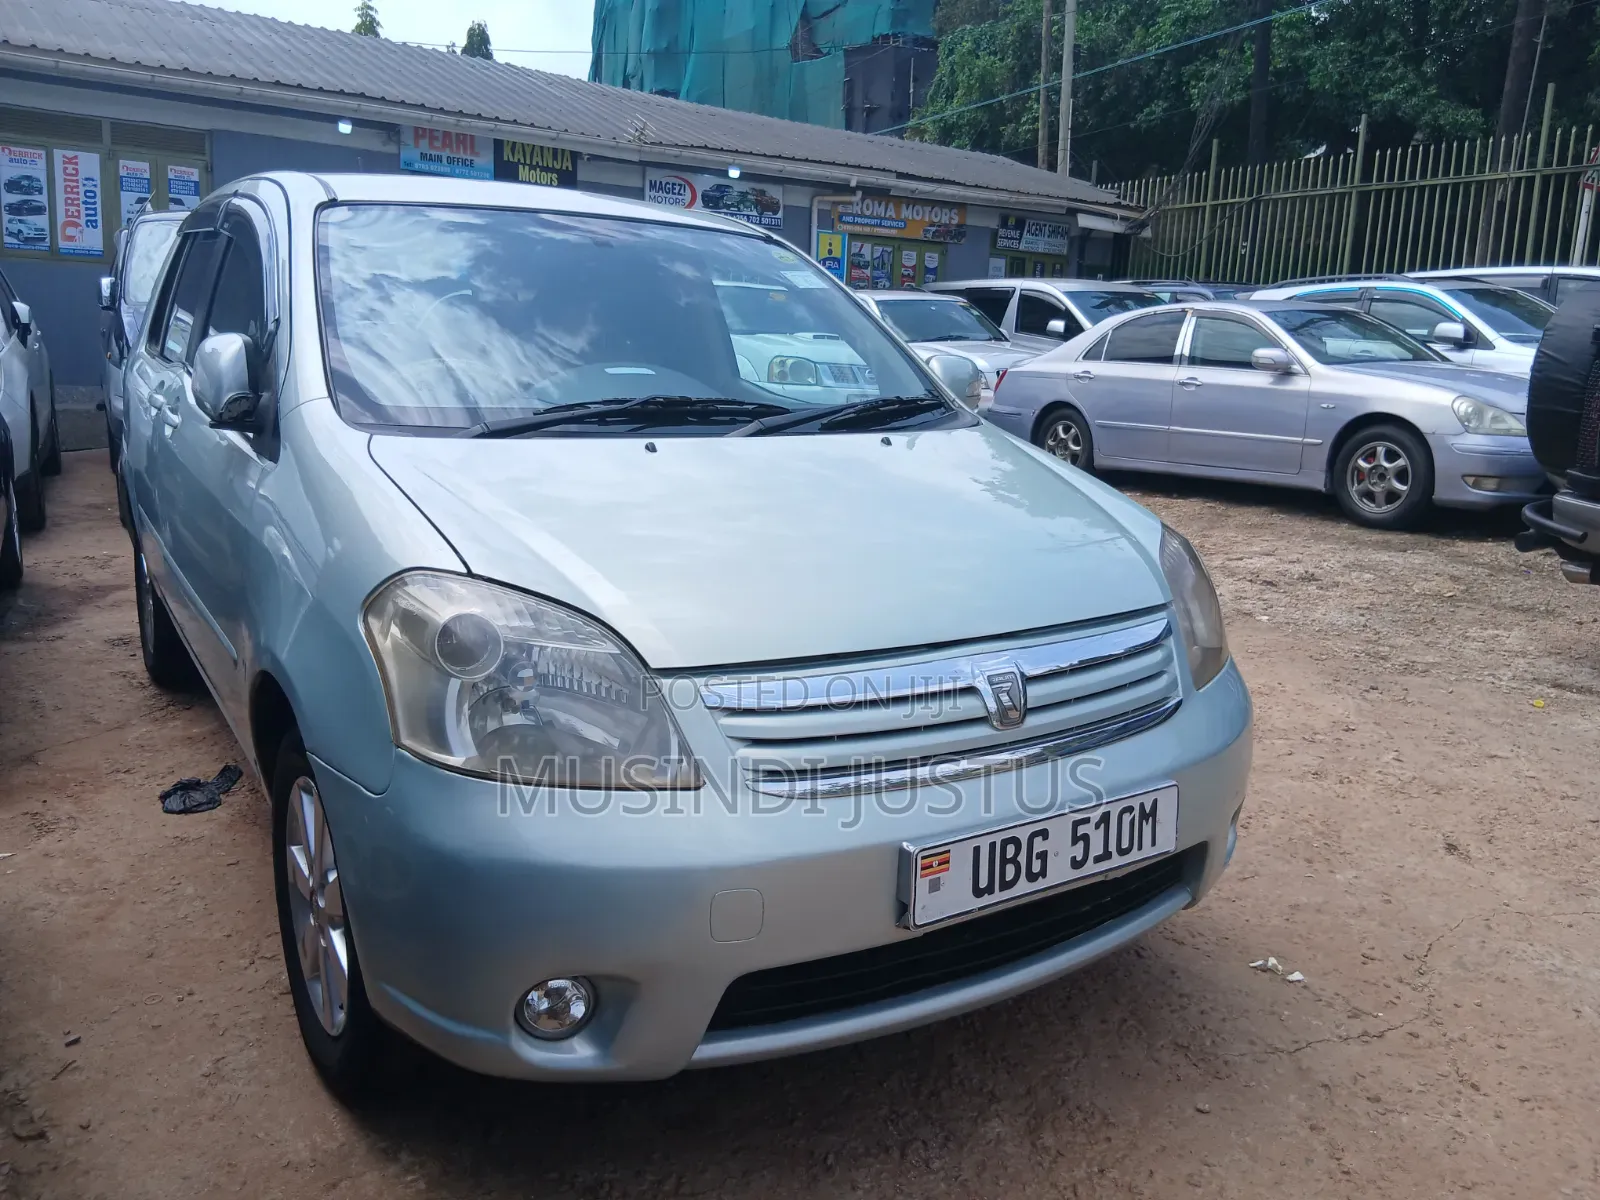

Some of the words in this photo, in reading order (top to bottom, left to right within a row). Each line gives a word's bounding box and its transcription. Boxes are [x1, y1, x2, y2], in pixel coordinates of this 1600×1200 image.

[413, 126, 480, 157] PEARL
[1, 146, 43, 160] DERRICK
[8, 157, 28, 165] auto
[420, 152, 443, 164] MAIN
[446, 155, 475, 168] OFFICE
[503, 140, 573, 172] KAYANJA
[518, 165, 558, 186] Motors
[61, 154, 82, 242] DERRICK
[648, 195, 686, 207] MOTORS
[81, 189, 98, 229] auto
[852, 199, 896, 219] ROMA
[901, 203, 959, 225] MOTORS
[748, 216, 760, 225] 702
[761, 218, 781, 226] 501311
[842, 216, 854, 224] AND
[854, 217, 881, 226] PROPERTY
[881, 219, 905, 228] SERVICES
[1026, 221, 1047, 237] AGENT
[999, 228, 1021, 239] REVENUE
[997, 238, 1020, 249] SERVICES
[820, 260, 839, 269] URA
[971, 827, 1050, 899] UBG
[1070, 798, 1158, 871] 510M
